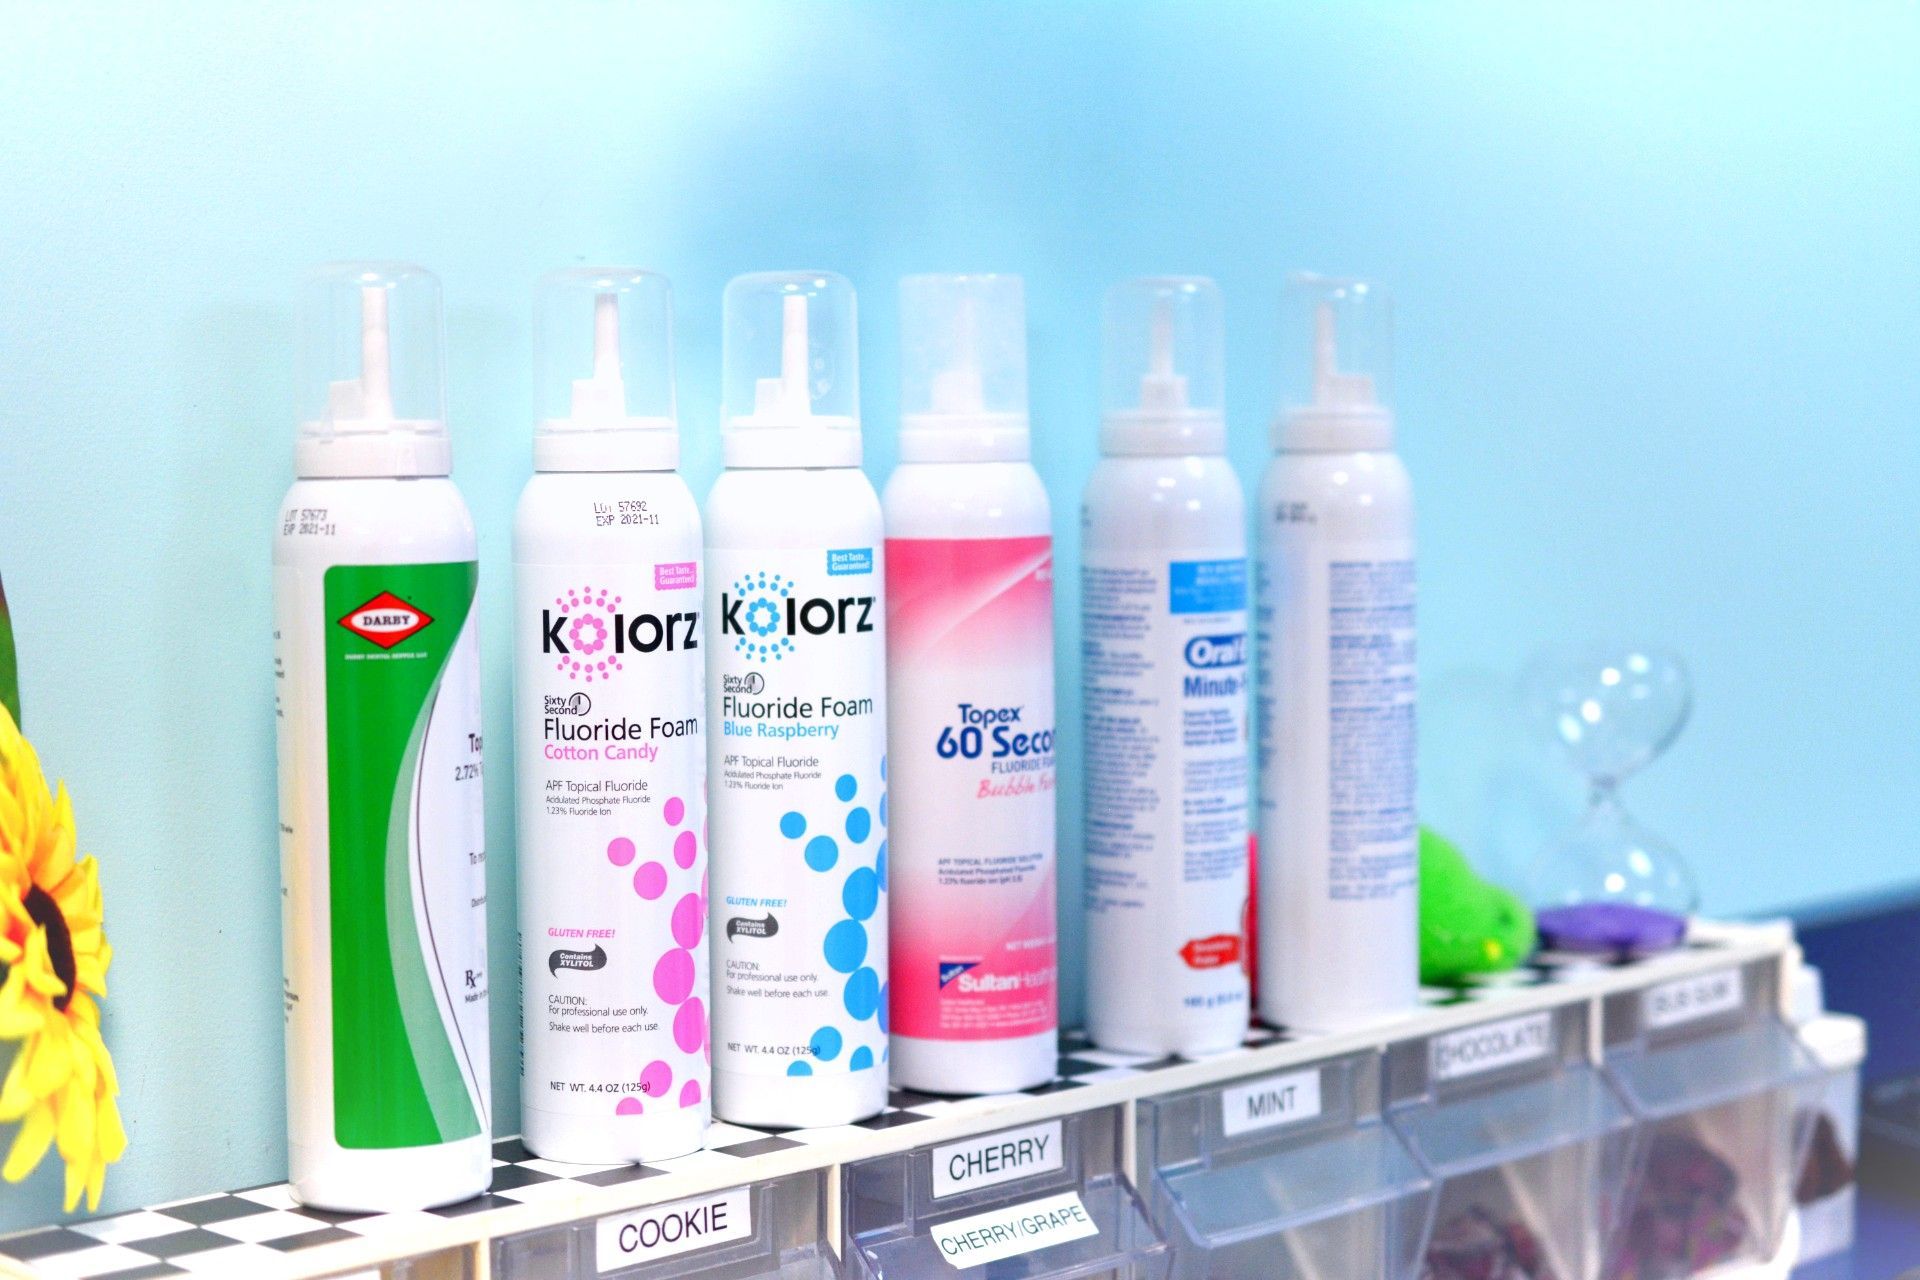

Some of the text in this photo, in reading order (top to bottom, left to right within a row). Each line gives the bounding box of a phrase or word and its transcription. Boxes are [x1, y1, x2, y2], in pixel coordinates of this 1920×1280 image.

[618, 500, 648, 512] 57692
[596, 513, 659, 526] EXP 2021-11
[363, 614, 410, 626] DARBY
[723, 674, 742, 686] Sixty
[723, 684, 752, 694] Second
[544, 695, 566, 707] Sixty
[723, 696, 873, 718] Fluoride Foam
[544, 705, 577, 715] Second
[958, 704, 1021, 728] Topex
[544, 717, 698, 741] Fluoride Foam
[724, 721, 839, 741] Blue Raspberry
[936, 725, 1056, 759] 60 Seco
[544, 743, 658, 762] Cotton Candy
[724, 755, 819, 769] APF Topical Fluoride
[992, 758, 1041, 774] FLUORIDE
[755, 771, 792, 780] Phosphate
[794, 770, 821, 779] Fluoride
[545, 779, 648, 794] APF Topical Fluoride
[546, 795, 651, 806] Acidulated Phosphate Fluoride
[569, 807, 597, 816] Fluoride
[599, 808, 612, 816] Ion
[726, 896, 788, 907] GLUTEN FREE!
[735, 920, 765, 928] Contains
[548, 927, 616, 938] GLUTEN FREE!
[736, 927, 767, 935] XYLITOL
[560, 952, 593, 960] Contains
[560, 960, 594, 968] XYLITOL
[726, 969, 736, 979] For
[737, 971, 782, 982] professional
[783, 973, 798, 982] use
[727, 986, 746, 996] Shake
[747, 988, 762, 997] well
[764, 988, 790, 998] before
[792, 988, 813, 998] each
[548, 1004, 560, 1015] For
[561, 1007, 610, 1017] professional
[612, 1007, 628, 1016] use
[549, 1021, 571, 1033] Shake
[573, 1024, 590, 1033] well
[591, 1023, 620, 1034] before
[622, 1022, 643, 1033] each
[727, 1042, 740, 1052] NET
[761, 1045, 775, 1055] 4.4
[776, 1046, 790, 1055] OZ
[550, 1080, 566, 1091] NET
[588, 1083, 604, 1093] 4.4
[605, 1083, 620, 1093] OZ
[621, 1081, 651, 1094] (125g)
[1247, 1086, 1297, 1119] MINT
[949, 1134, 1049, 1181] CHERRY
[619, 1202, 728, 1253] COOKIE
[941, 1205, 1087, 1255] CHERRY/GRAPE
